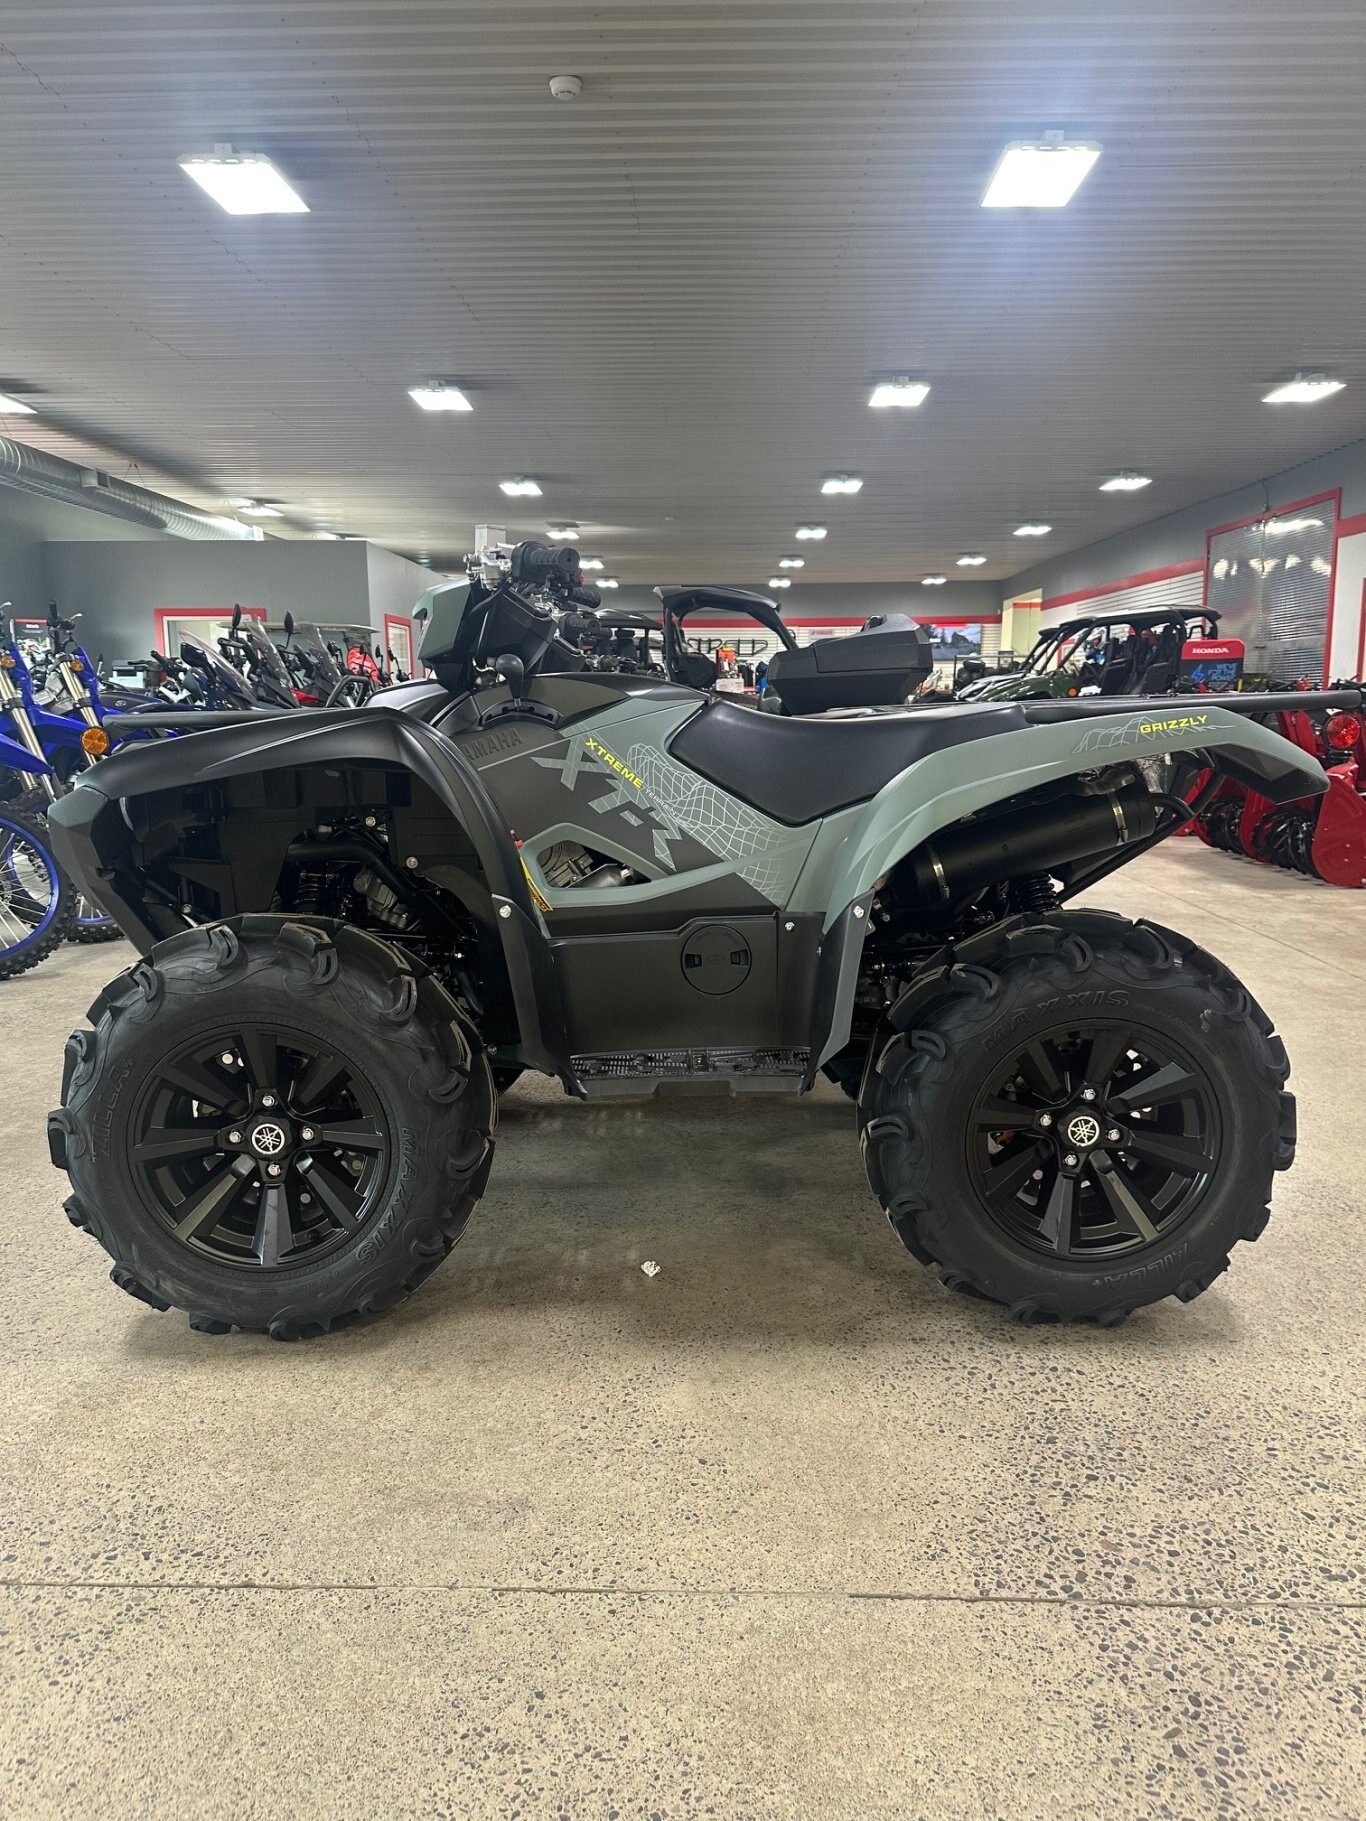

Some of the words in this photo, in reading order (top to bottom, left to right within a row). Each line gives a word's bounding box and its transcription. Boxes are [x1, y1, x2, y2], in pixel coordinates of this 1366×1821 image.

[460, 727, 524, 761] AMAHA
[1140, 715, 1207, 734] GRIZZLY
[586, 737, 645, 789] XTREME
[645, 789, 679, 816] TERRAIN
[982, 989, 1130, 1051] MAXXIS
[355, 1127, 418, 1266] MAXXIS
